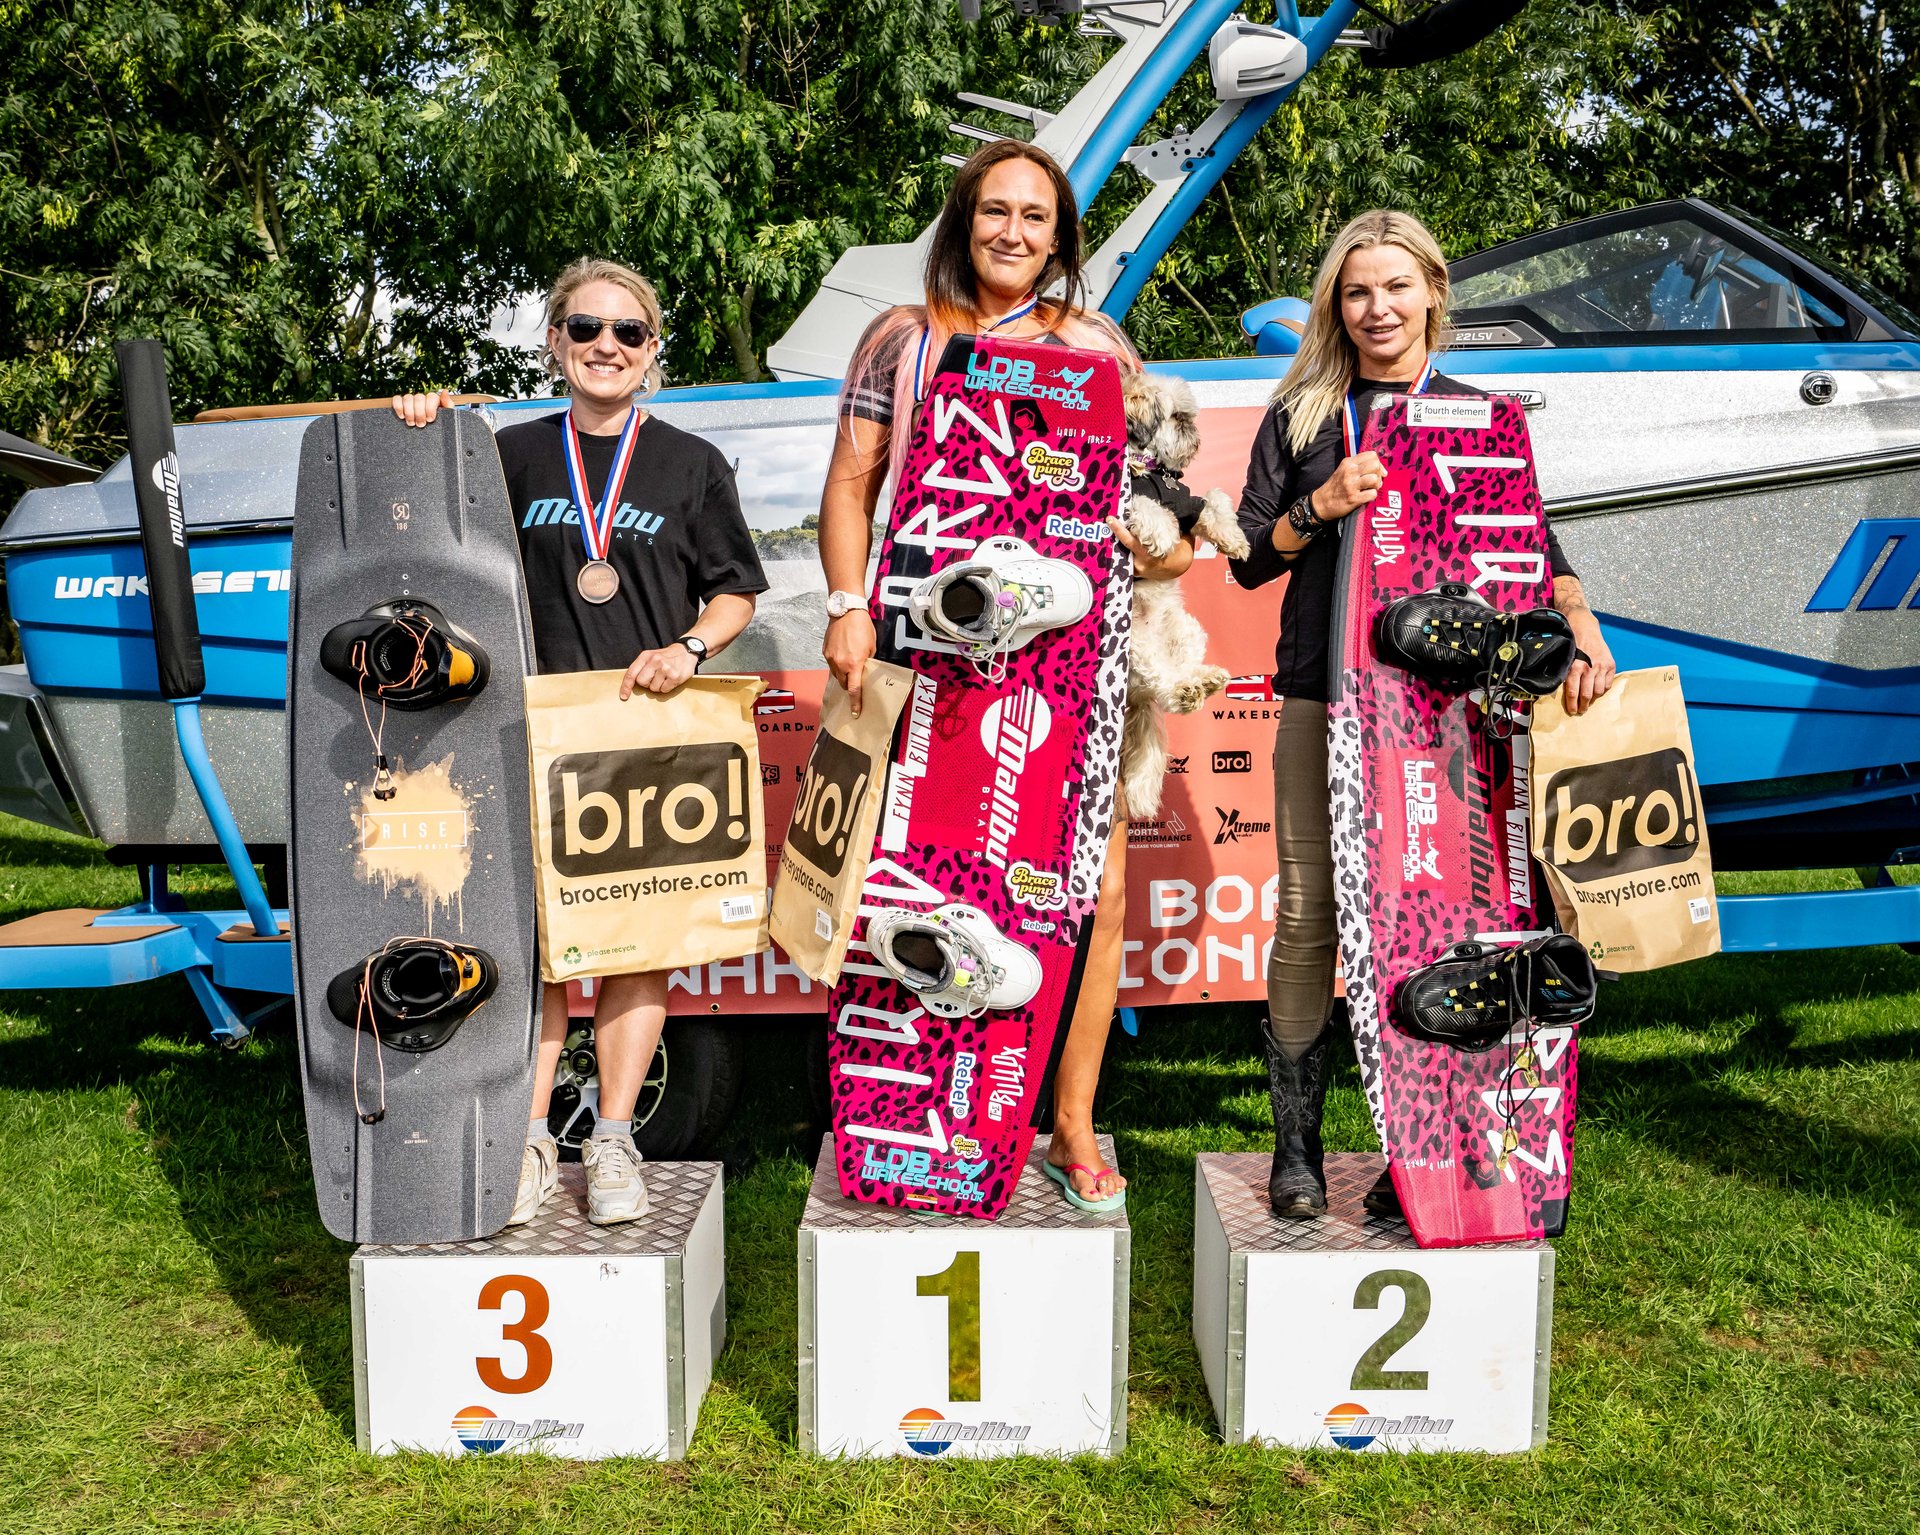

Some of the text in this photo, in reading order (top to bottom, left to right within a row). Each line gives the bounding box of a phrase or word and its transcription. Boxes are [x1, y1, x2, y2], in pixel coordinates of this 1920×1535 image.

[967, 353, 1036, 383] LDB
[964, 375, 1091, 404] WAKESCHOOL
[1424, 406, 1486, 417] fourth element
[1028, 447, 1072, 467] Brace
[1034, 461, 1078, 486] pimp
[522, 498, 665, 535] Mabu
[1214, 754, 1251, 770] bro!
[562, 758, 745, 856] bro!
[893, 772, 915, 820] FYNN
[1414, 760, 1438, 824] LDB
[974, 786, 990, 858] BOATS
[1404, 760, 1421, 882] WAKESCHOOL
[1554, 762, 1696, 865] bro!
[382, 821, 447, 839] RISE
[560, 869, 748, 906] brocerystore.com
[1011, 867, 1055, 886] Brace
[1573, 872, 1701, 906] brocerystore.com
[1018, 881, 1060, 904] pimp
[587, 944, 637, 959] please recycle
[863, 1144, 931, 1172] LDB
[861, 1166, 985, 1197] WAKESCHOOL
[476, 1275, 552, 1394] 3
[916, 1251, 981, 1402] 1
[1350, 1270, 1431, 1390] 2
[925, 1422, 1031, 1441] Malibu
[1349, 1415, 1454, 1435] Malibu
